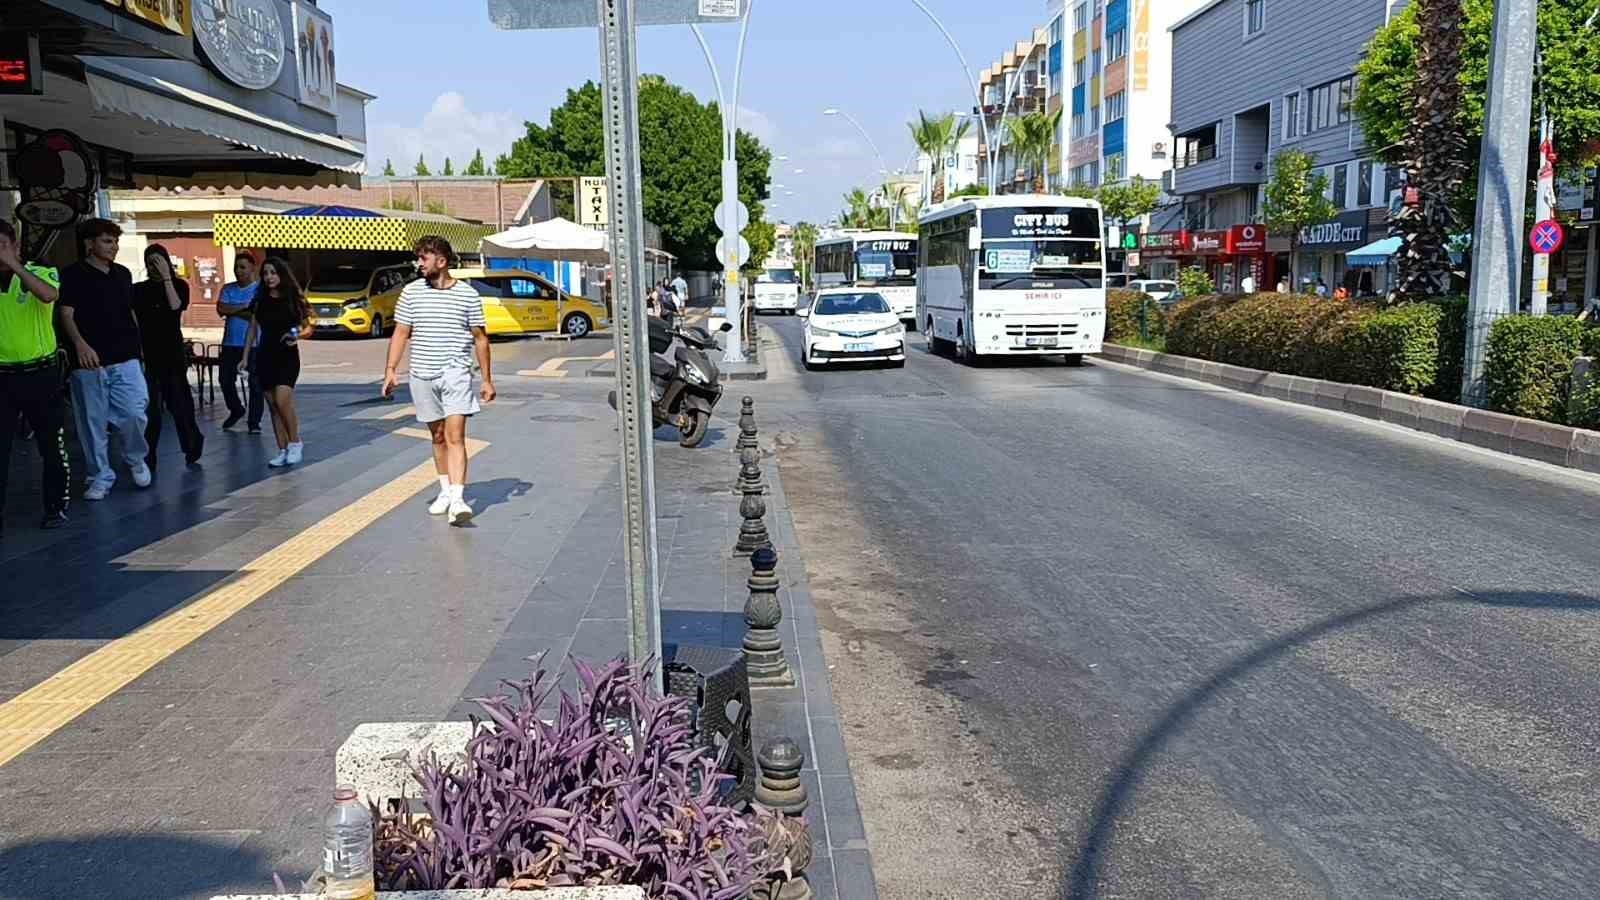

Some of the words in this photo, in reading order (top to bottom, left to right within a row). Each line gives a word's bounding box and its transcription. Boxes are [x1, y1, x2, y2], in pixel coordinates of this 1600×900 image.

[592, 187, 602, 222] TAXI
[1013, 214, 1043, 227] CITY
[1044, 214, 1069, 227] BUS
[872, 241, 892, 251] CITY
[892, 241, 910, 251] BUS
[988, 251, 998, 269] 6
